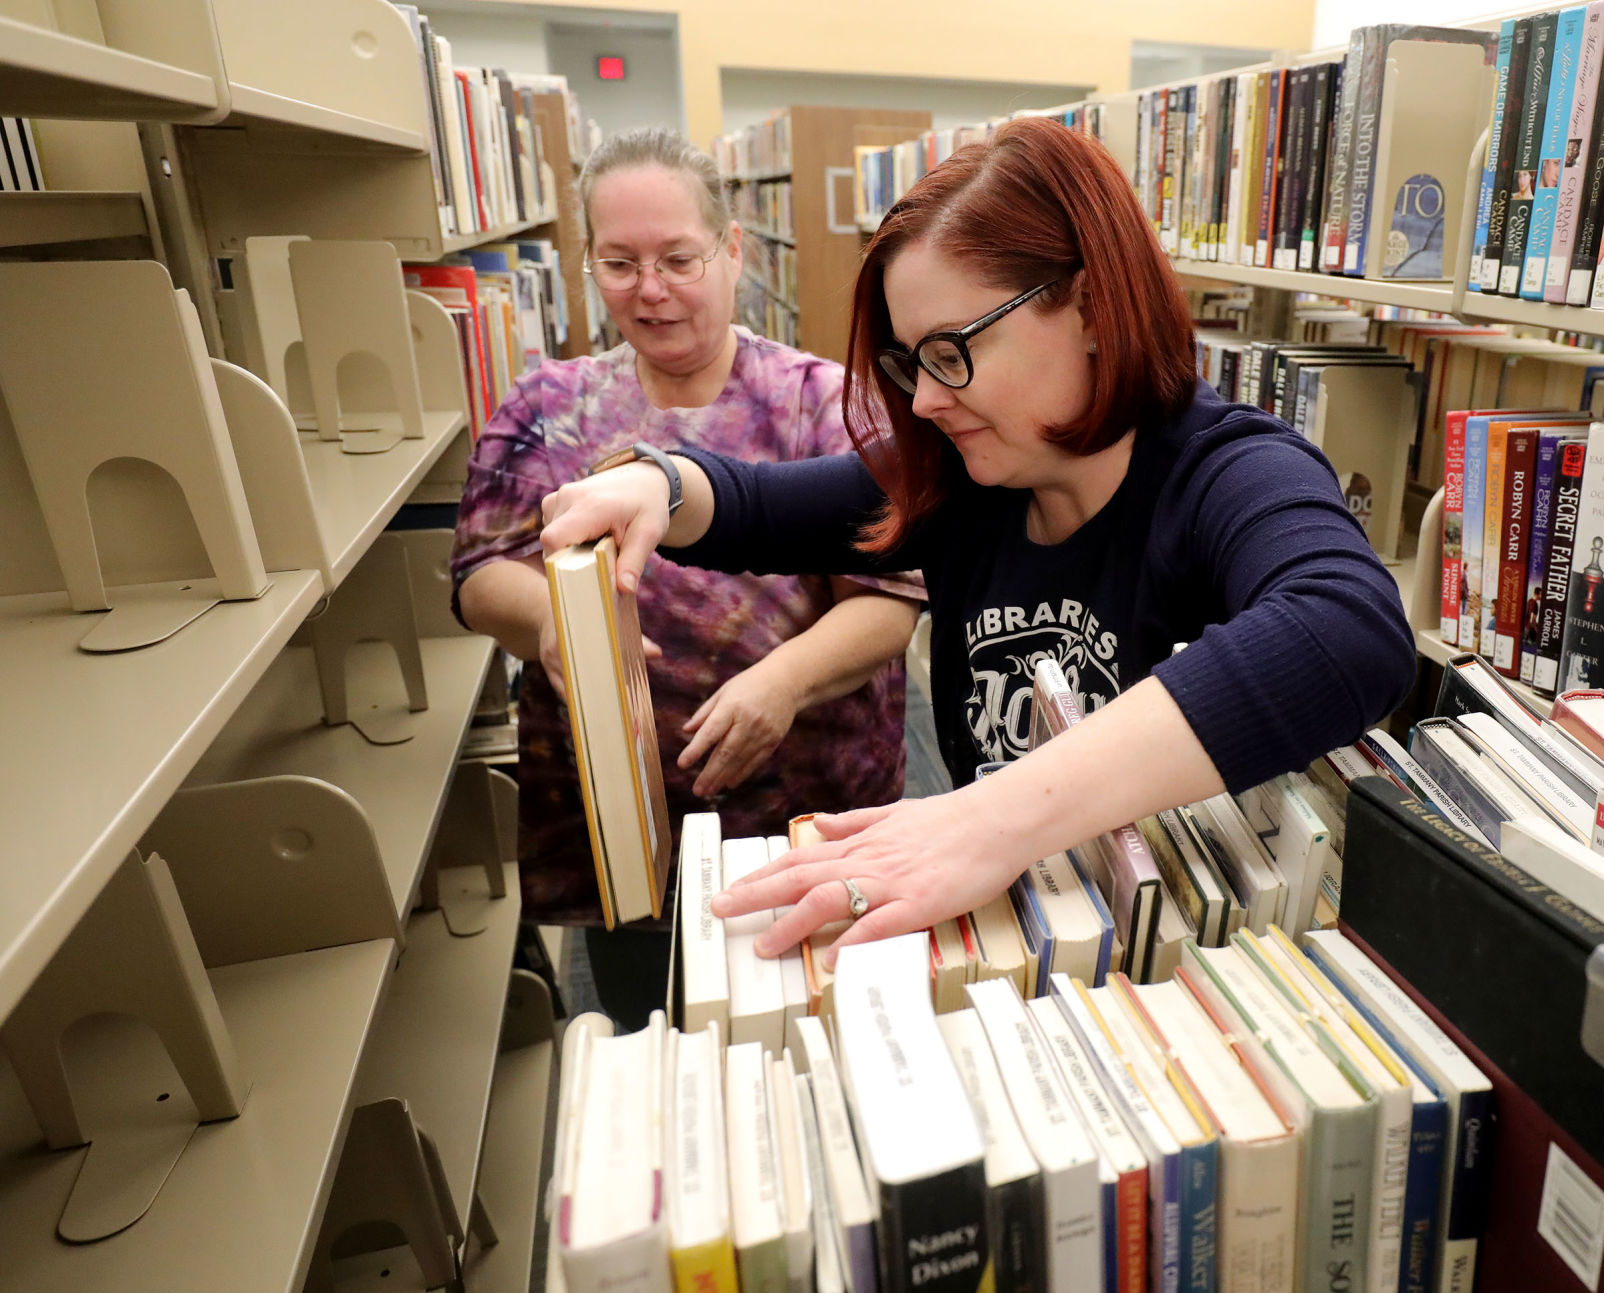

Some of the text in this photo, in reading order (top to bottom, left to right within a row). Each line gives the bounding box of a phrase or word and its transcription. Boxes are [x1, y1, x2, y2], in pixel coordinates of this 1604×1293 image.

[1578, 35, 1597, 90] Marriage
[1498, 66, 1509, 100] GAME
[1495, 102, 1505, 117] OF
[1525, 98, 1539, 144] WITHOUT
[1488, 120, 1502, 173] MIRRORS
[1522, 144, 1532, 167] END
[1348, 113, 1375, 247] INTO THE STORM
[1591, 157, 1604, 206] GOOSE
[1329, 168, 1347, 236] NATURE
[1402, 183, 1443, 218] TO
[1482, 187, 1494, 225] ANDREA
[1489, 201, 1500, 236] CAMP
[1493, 189, 1508, 246] CANDACE
[1560, 177, 1577, 245] CANDACE
[1507, 216, 1519, 251] CAMP
[1512, 205, 1529, 260] CANDACE
[1250, 349, 1262, 378] DALE
[1275, 367, 1286, 395] DALE
[1296, 395, 1306, 421] DALE
[1446, 472, 1456, 508] CARR
[1455, 473, 1464, 508] ROBYN
[1535, 489, 1544, 528] CARR
[1542, 490, 1551, 528] ROBYN
[1507, 471, 1525, 561] ROBYN CARR
[1554, 486, 1580, 542] SECRET
[1442, 568, 1451, 599] POINT
[1450, 562, 1459, 606] SUNRISE
[1545, 545, 1572, 602] FATHER
[966, 599, 1118, 660] LIBRARIES
[1541, 608, 1553, 648] CARROLL
[1552, 610, 1563, 639] JAMES
[1412, 767, 1436, 791] TAMMANY
[1432, 788, 1452, 808] PARISH
[1448, 805, 1472, 829] LIBRARY
[1553, 787, 1577, 811] LIBRARY
[1400, 798, 1427, 816] THE
[1421, 811, 1468, 844] LEGACY
[1120, 824, 1146, 859] ATCH
[908, 1225, 979, 1259] Nancy
[1326, 1193, 1355, 1293] THE SO
[911, 1251, 980, 1287] Dixon
